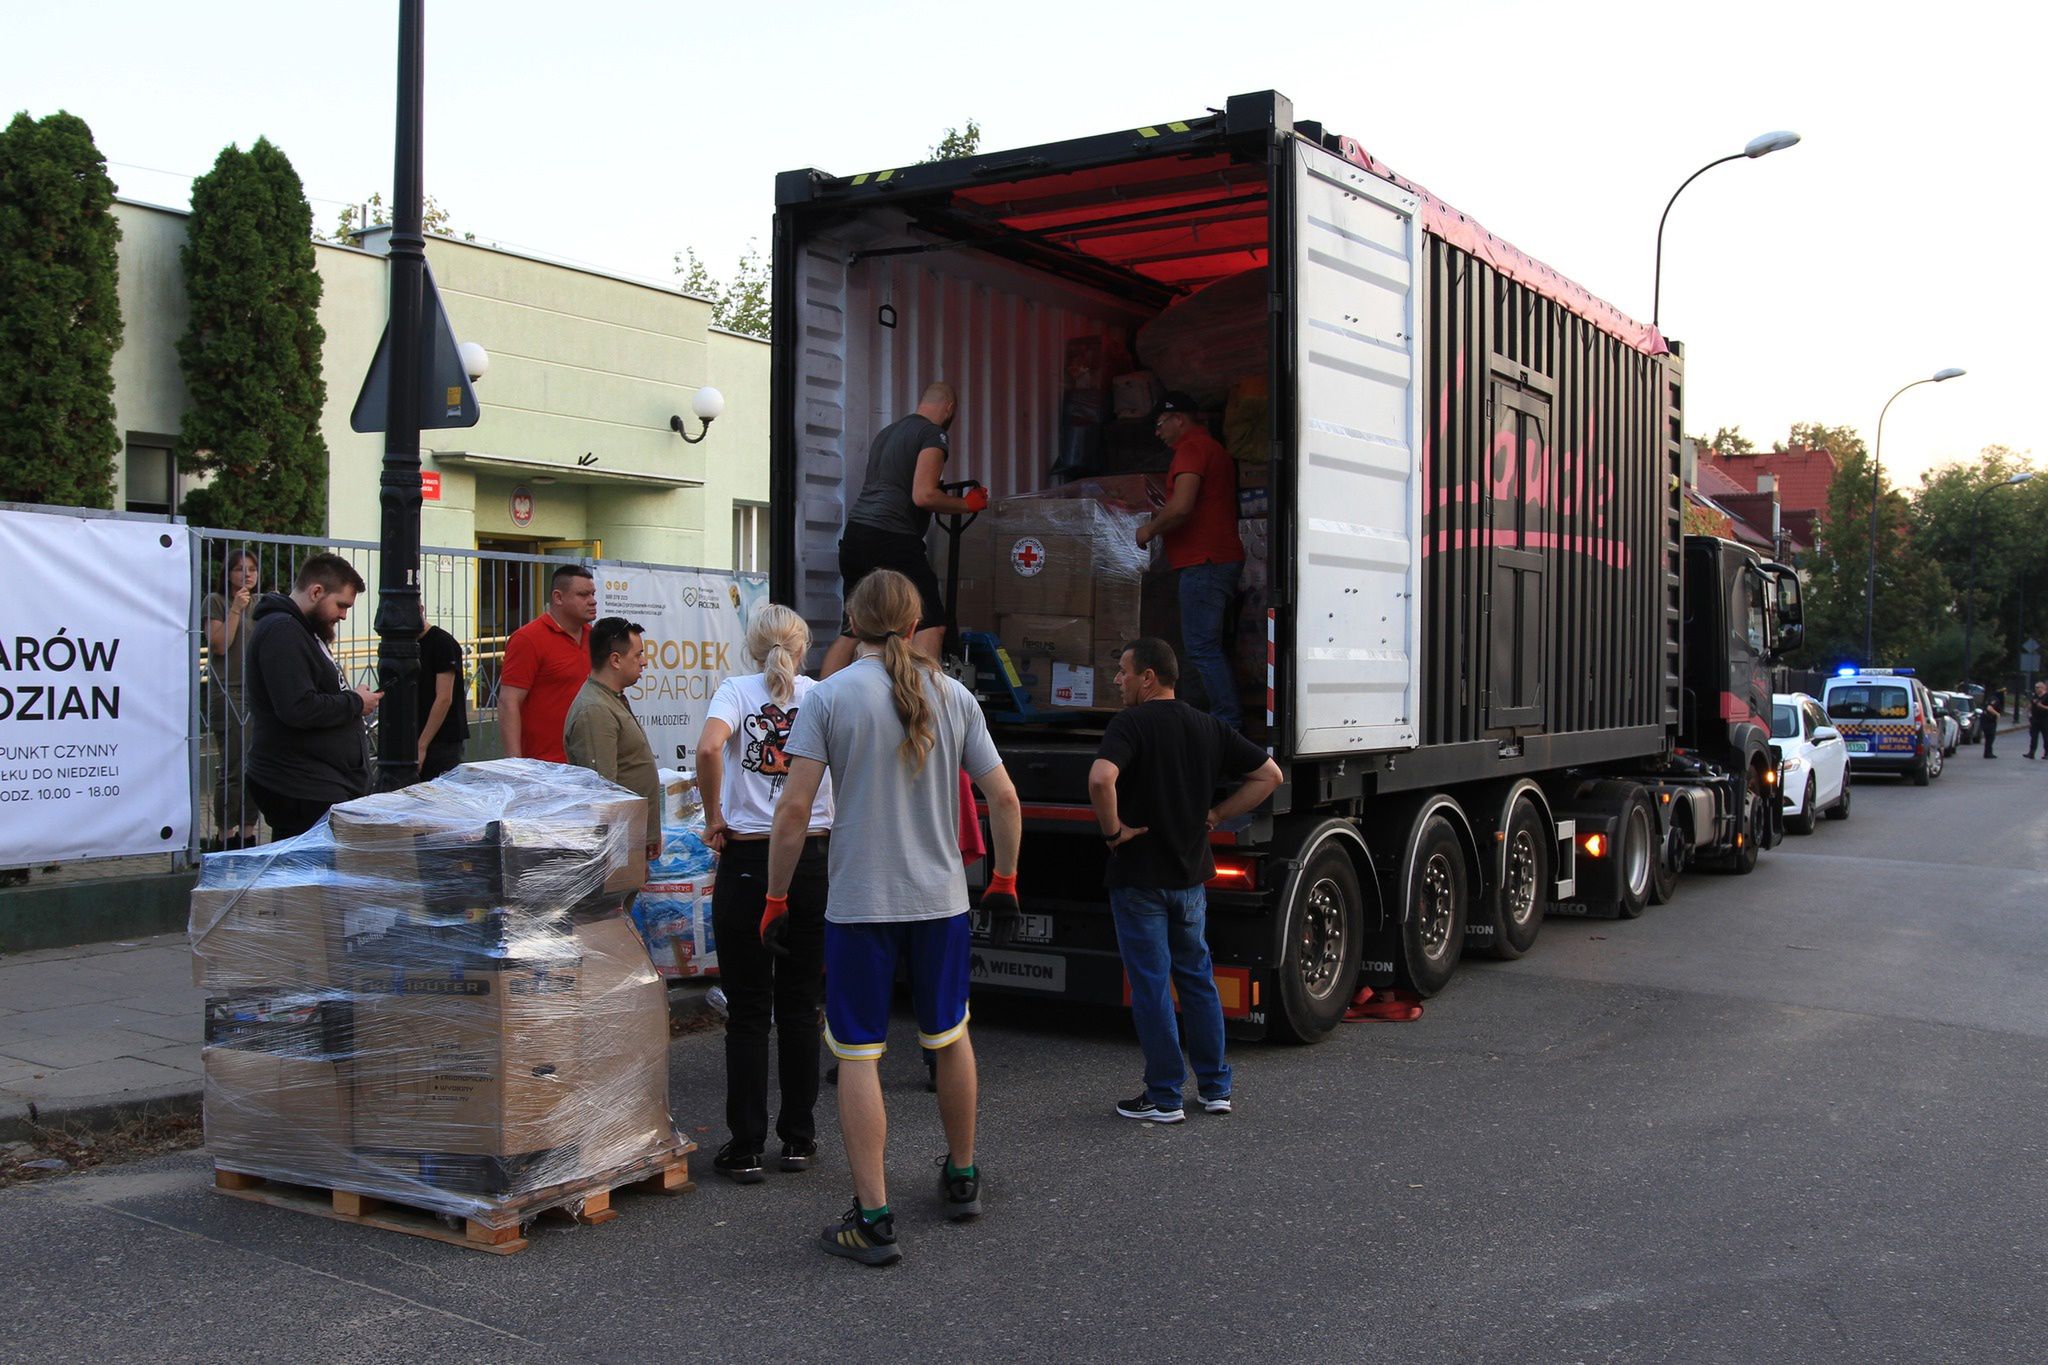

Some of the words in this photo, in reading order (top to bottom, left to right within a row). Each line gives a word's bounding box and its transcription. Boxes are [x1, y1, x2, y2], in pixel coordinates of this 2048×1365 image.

[1883, 736, 1909, 744] STRAŻ
[53, 743, 119, 759] CZYNNY
[1, 769, 28, 781] ŁKU
[32, 768, 53, 780] DO
[57, 765, 119, 779] NIEDZIELI
[0, 790, 33, 802] ODZ.
[37, 787, 71, 800] 10.00
[88, 785, 120, 798] 18.00
[989, 960, 1054, 979] WIELTON
